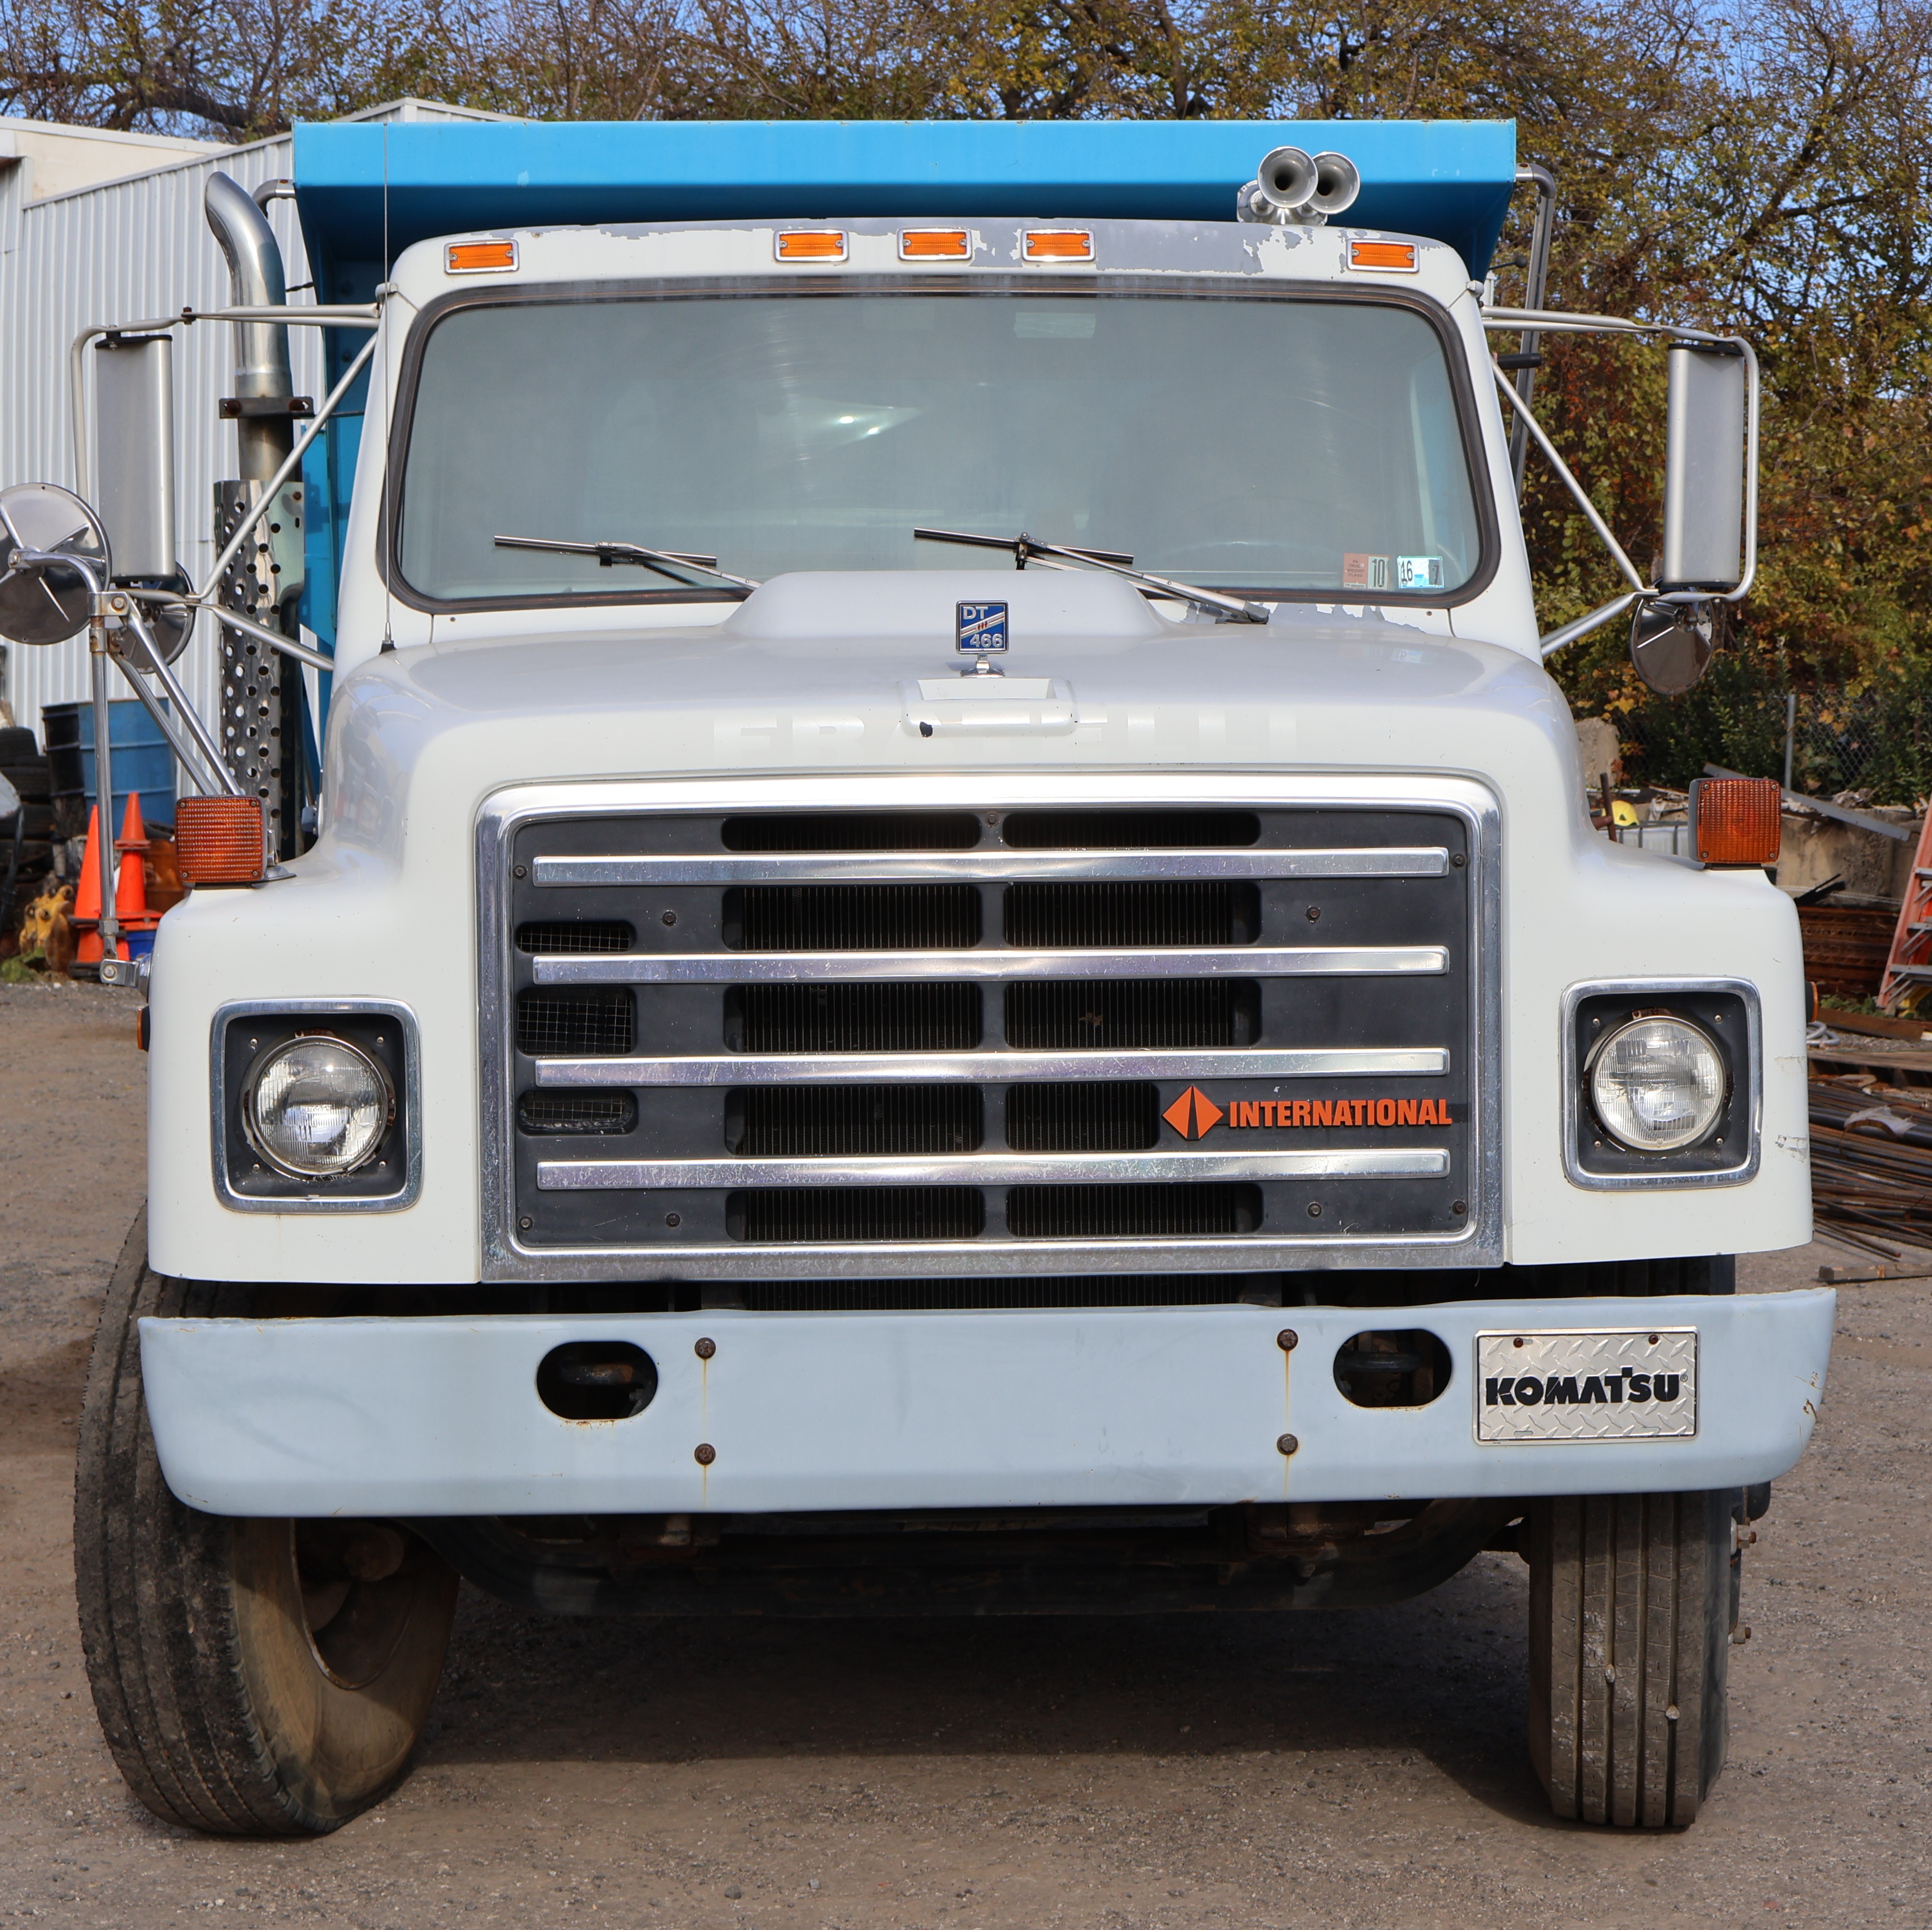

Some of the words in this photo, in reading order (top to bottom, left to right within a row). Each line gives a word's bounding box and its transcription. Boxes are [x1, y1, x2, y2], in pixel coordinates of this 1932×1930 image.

[1371, 559, 1385, 587] 10
[1401, 560, 1413, 582] 16
[963, 606, 988, 620] DT
[970, 634, 1003, 648] 466
[1229, 1098, 1452, 1128] INTERNATIONAL
